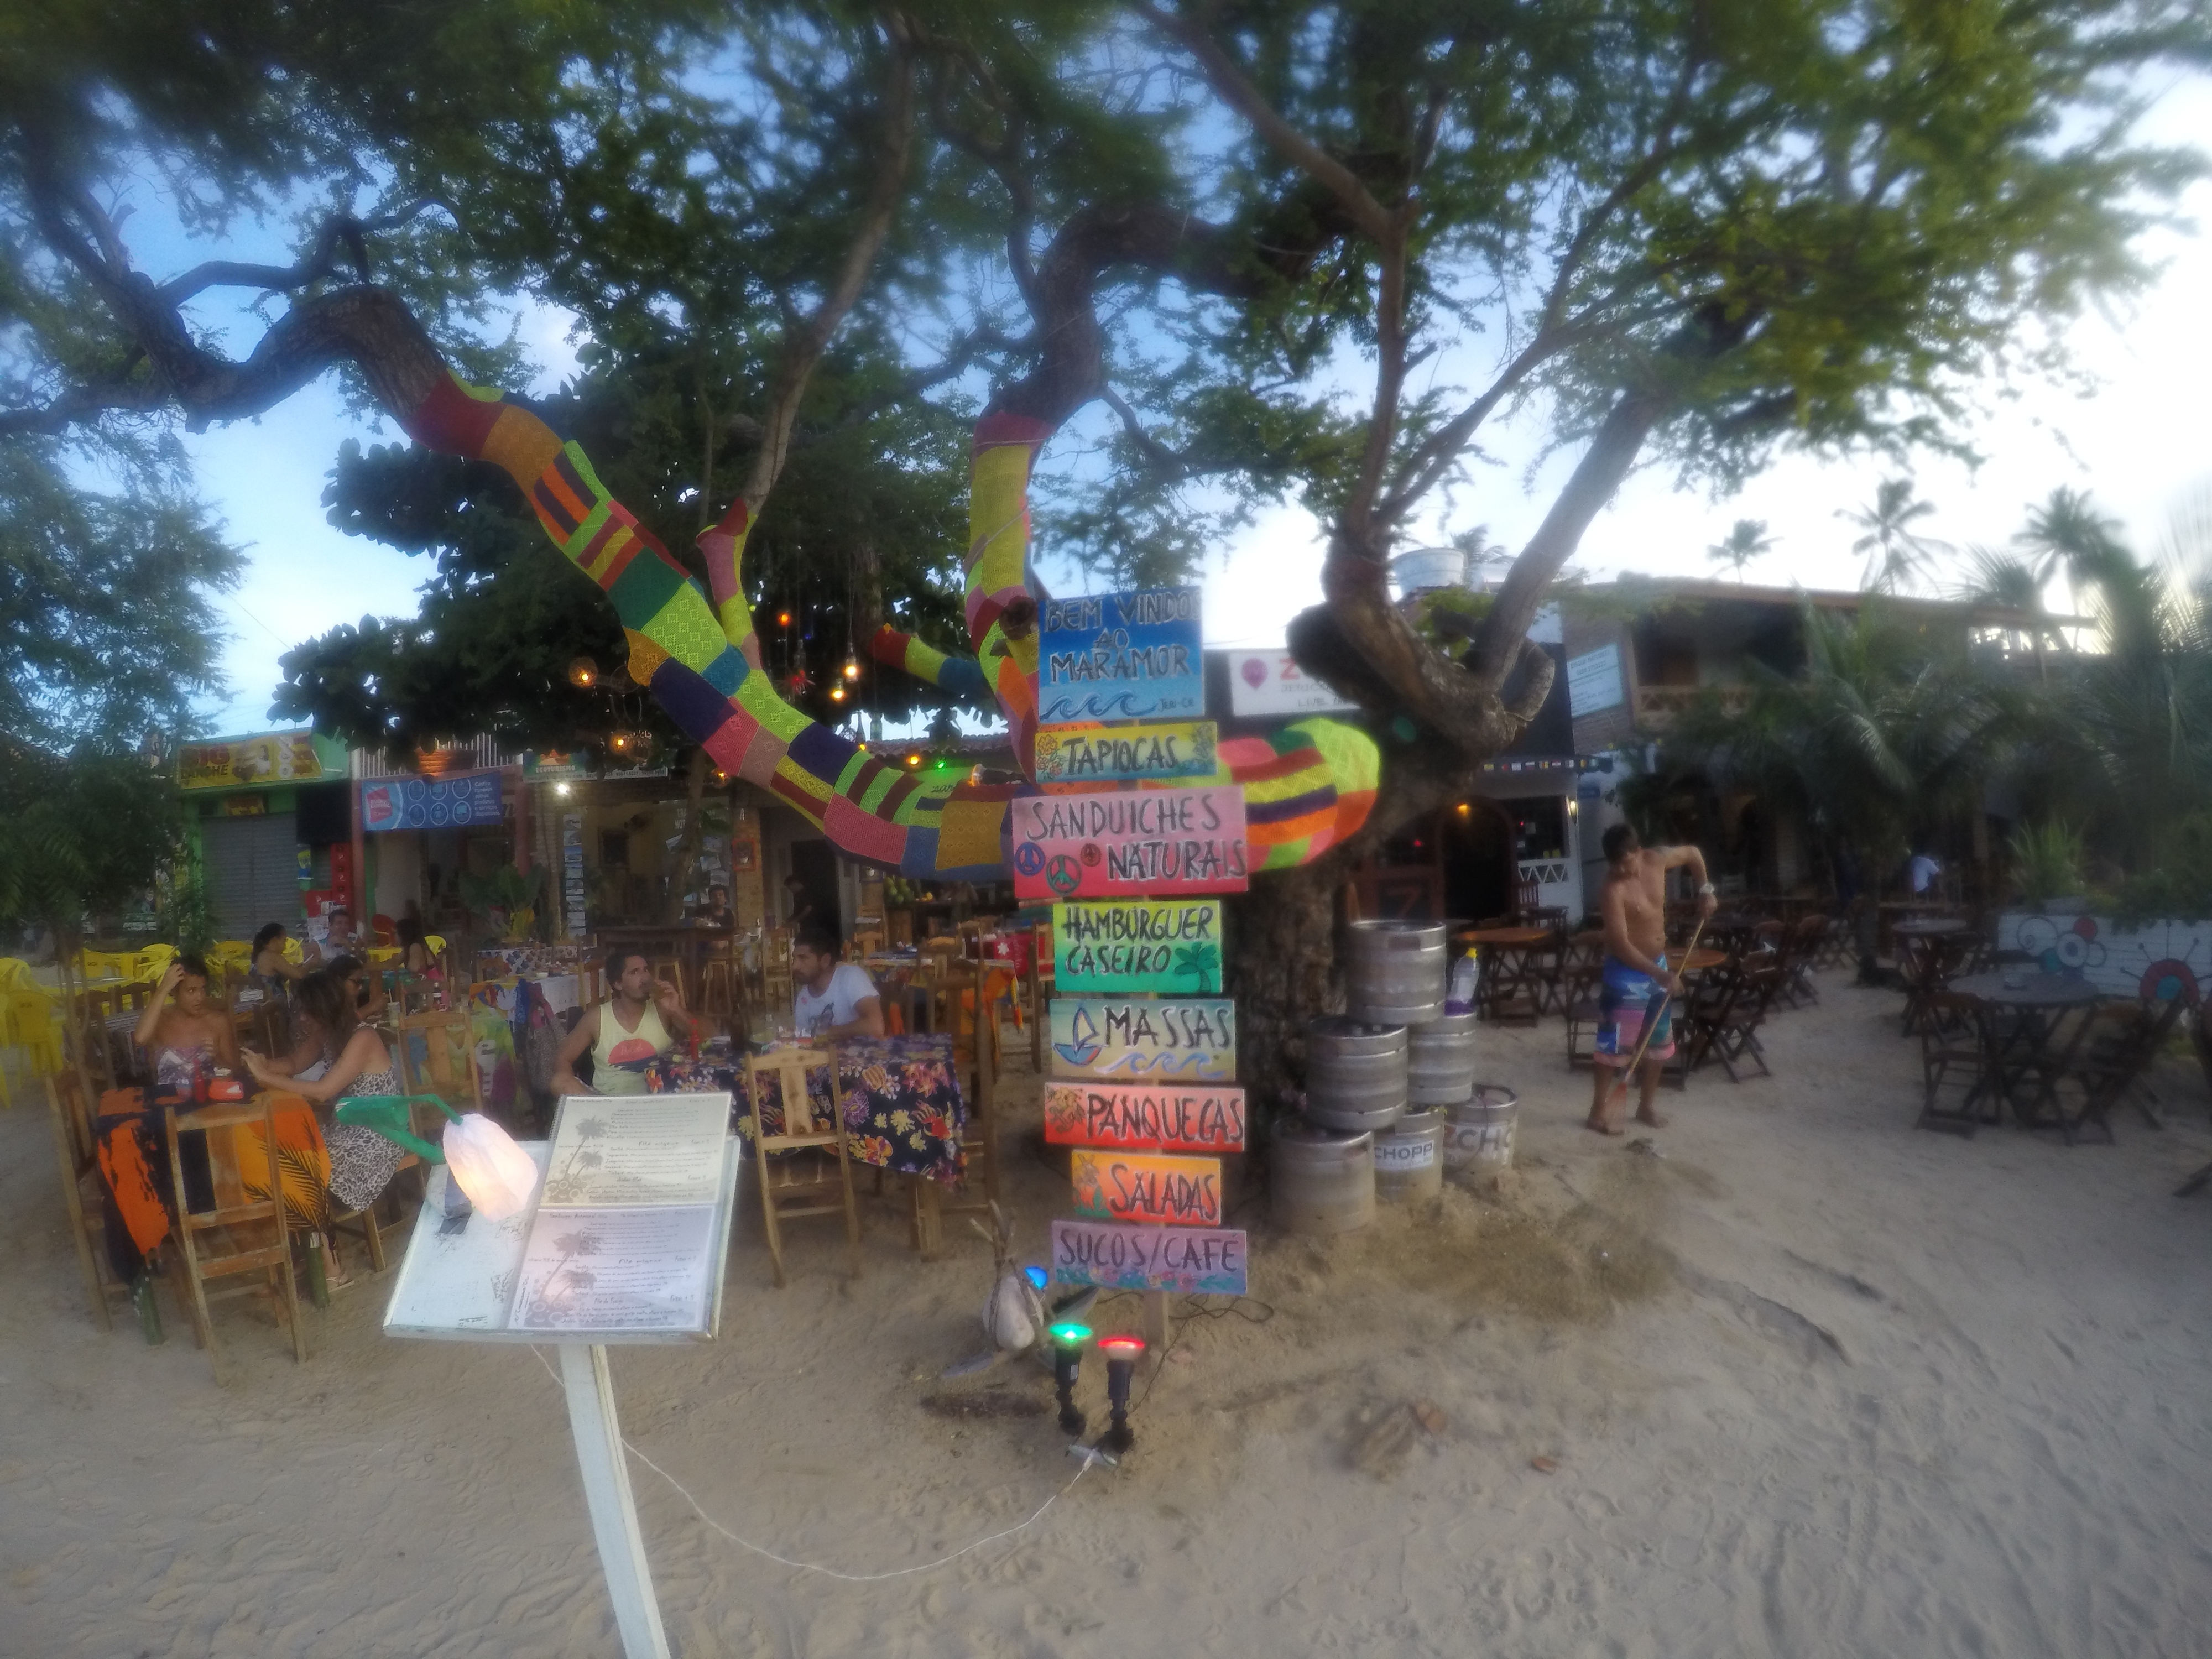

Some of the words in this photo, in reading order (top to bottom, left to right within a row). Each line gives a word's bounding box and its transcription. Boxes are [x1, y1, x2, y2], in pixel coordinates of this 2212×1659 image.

[1046, 598, 1103, 632] BEM
[1114, 591, 1201, 627] VINDOS
[1093, 628, 1130, 650] AO
[1050, 644, 1190, 684] MARAMOR
[1062, 734, 1178, 775] TAPIOCAS
[1026, 793, 1221, 841] SANDUICHES
[1108, 839, 1247, 880] NATURAIS
[1061, 905, 1214, 943] HAMBURGUER
[1065, 943, 1171, 978] CASEIRO
[1104, 1005, 1232, 1049] MASSAS
[1086, 1092, 1244, 1143] PANQUECAS
[1374, 1142, 1433, 1160] CHOPP
[1109, 1162, 1218, 1222] SALADAS
